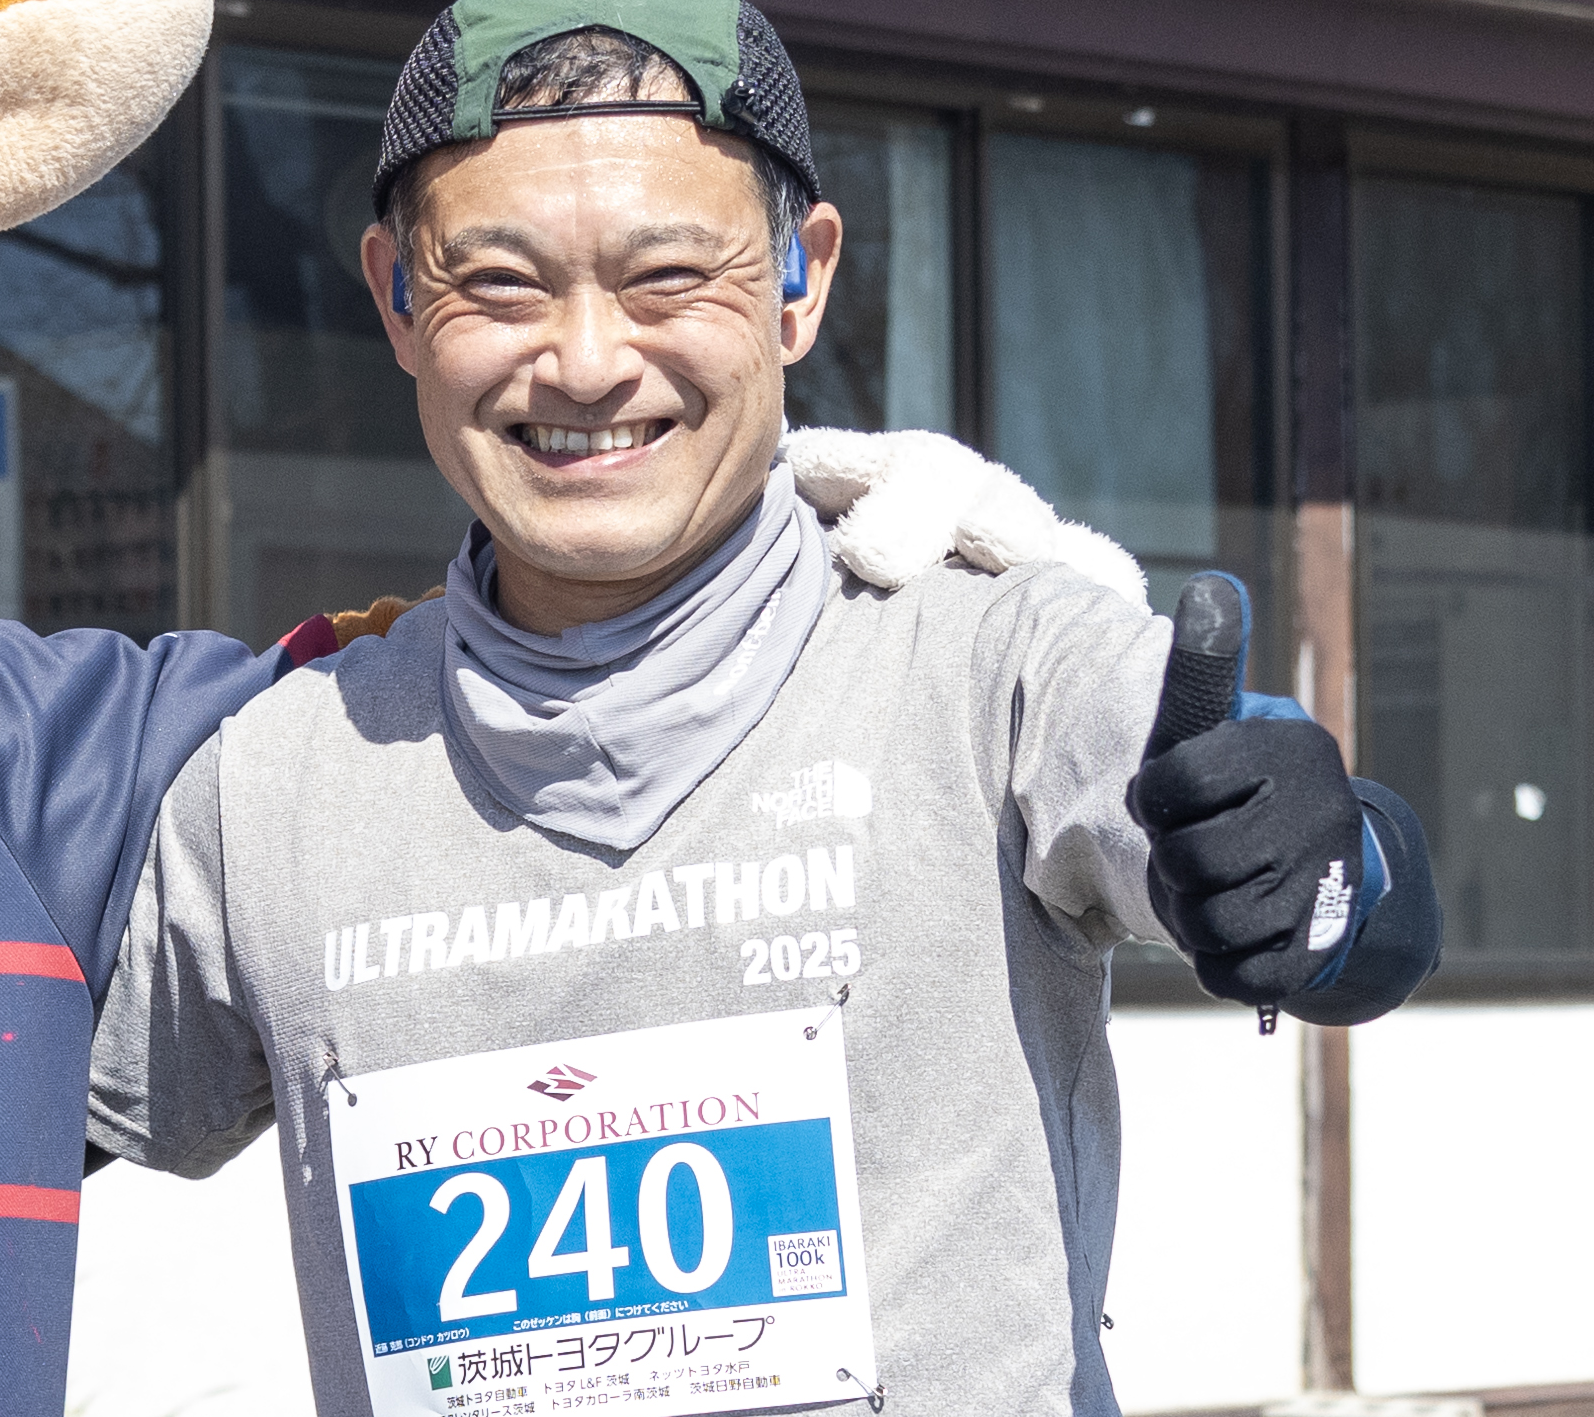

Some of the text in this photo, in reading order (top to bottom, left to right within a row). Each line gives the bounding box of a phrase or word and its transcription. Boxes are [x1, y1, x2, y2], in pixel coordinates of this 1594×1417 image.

[791, 760, 833, 790] THE
[751, 776, 833, 813] NORTH
[776, 797, 833, 830] FACE
[325, 844, 856, 992] ULTRAMARATHON
[740, 927, 862, 986] 2025
[395, 1092, 761, 1170] RY CORPORATION
[429, 1142, 734, 1323] 240
[773, 1235, 831, 1252] IBARAKI
[776, 1248, 825, 1269] 100k
[777, 1268, 806, 1277] ULTRA
[457, 1315, 776, 1386] 茨城トヨタグループ
[446, 1385, 529, 1410] 茨城トヨタ自動車
[649, 1360, 751, 1382] ネッツトヨタ水戸
[552, 1384, 671, 1411] トヨタカローラ南茨城
[689, 1373, 782, 1396] 茨城日野自動車
